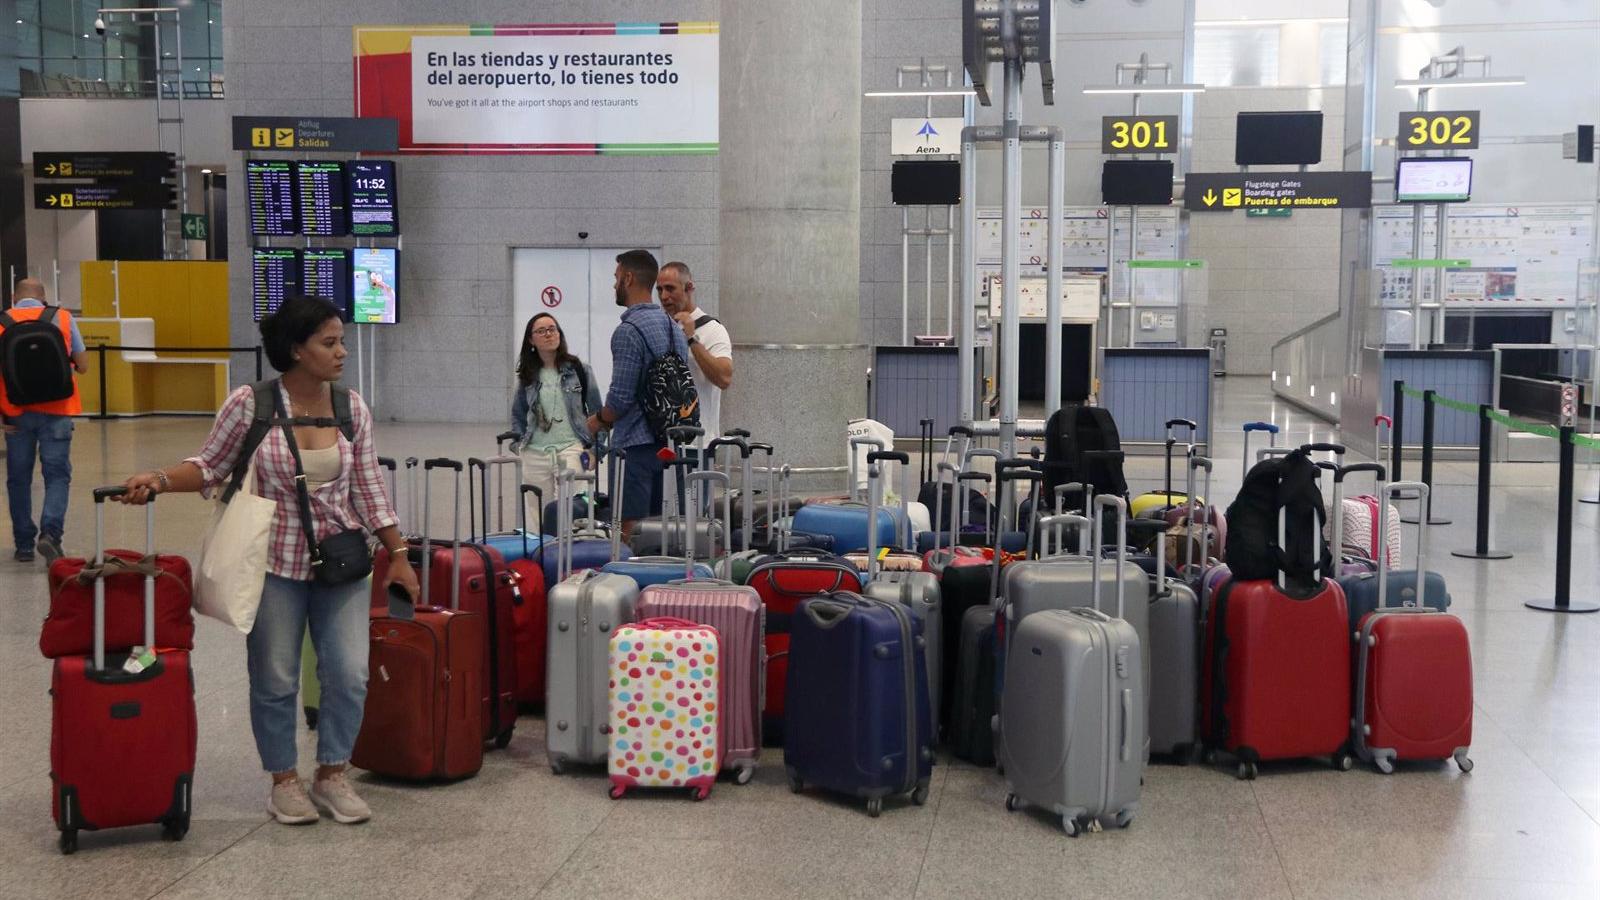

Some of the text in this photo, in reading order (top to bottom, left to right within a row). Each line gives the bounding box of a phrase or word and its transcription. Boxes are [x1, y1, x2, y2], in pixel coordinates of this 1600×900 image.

[427, 51, 673, 69] En las tiendas y restaurantes
[427, 69, 679, 88] del aeropuerto, lo tienes todo
[427, 98, 639, 108] You've got it all at the airport shops and restaurants
[1111, 121, 1169, 148] 301
[1407, 116, 1472, 145] 302
[298, 138, 329, 147] Salidas
[915, 146, 941, 154] Aena
[356, 179, 385, 189] 11:52
[1245, 180, 1302, 189] Flugsteige Gates
[1245, 189, 1296, 197] Boarding gates
[1245, 196, 1338, 206] Puertas de embarque
